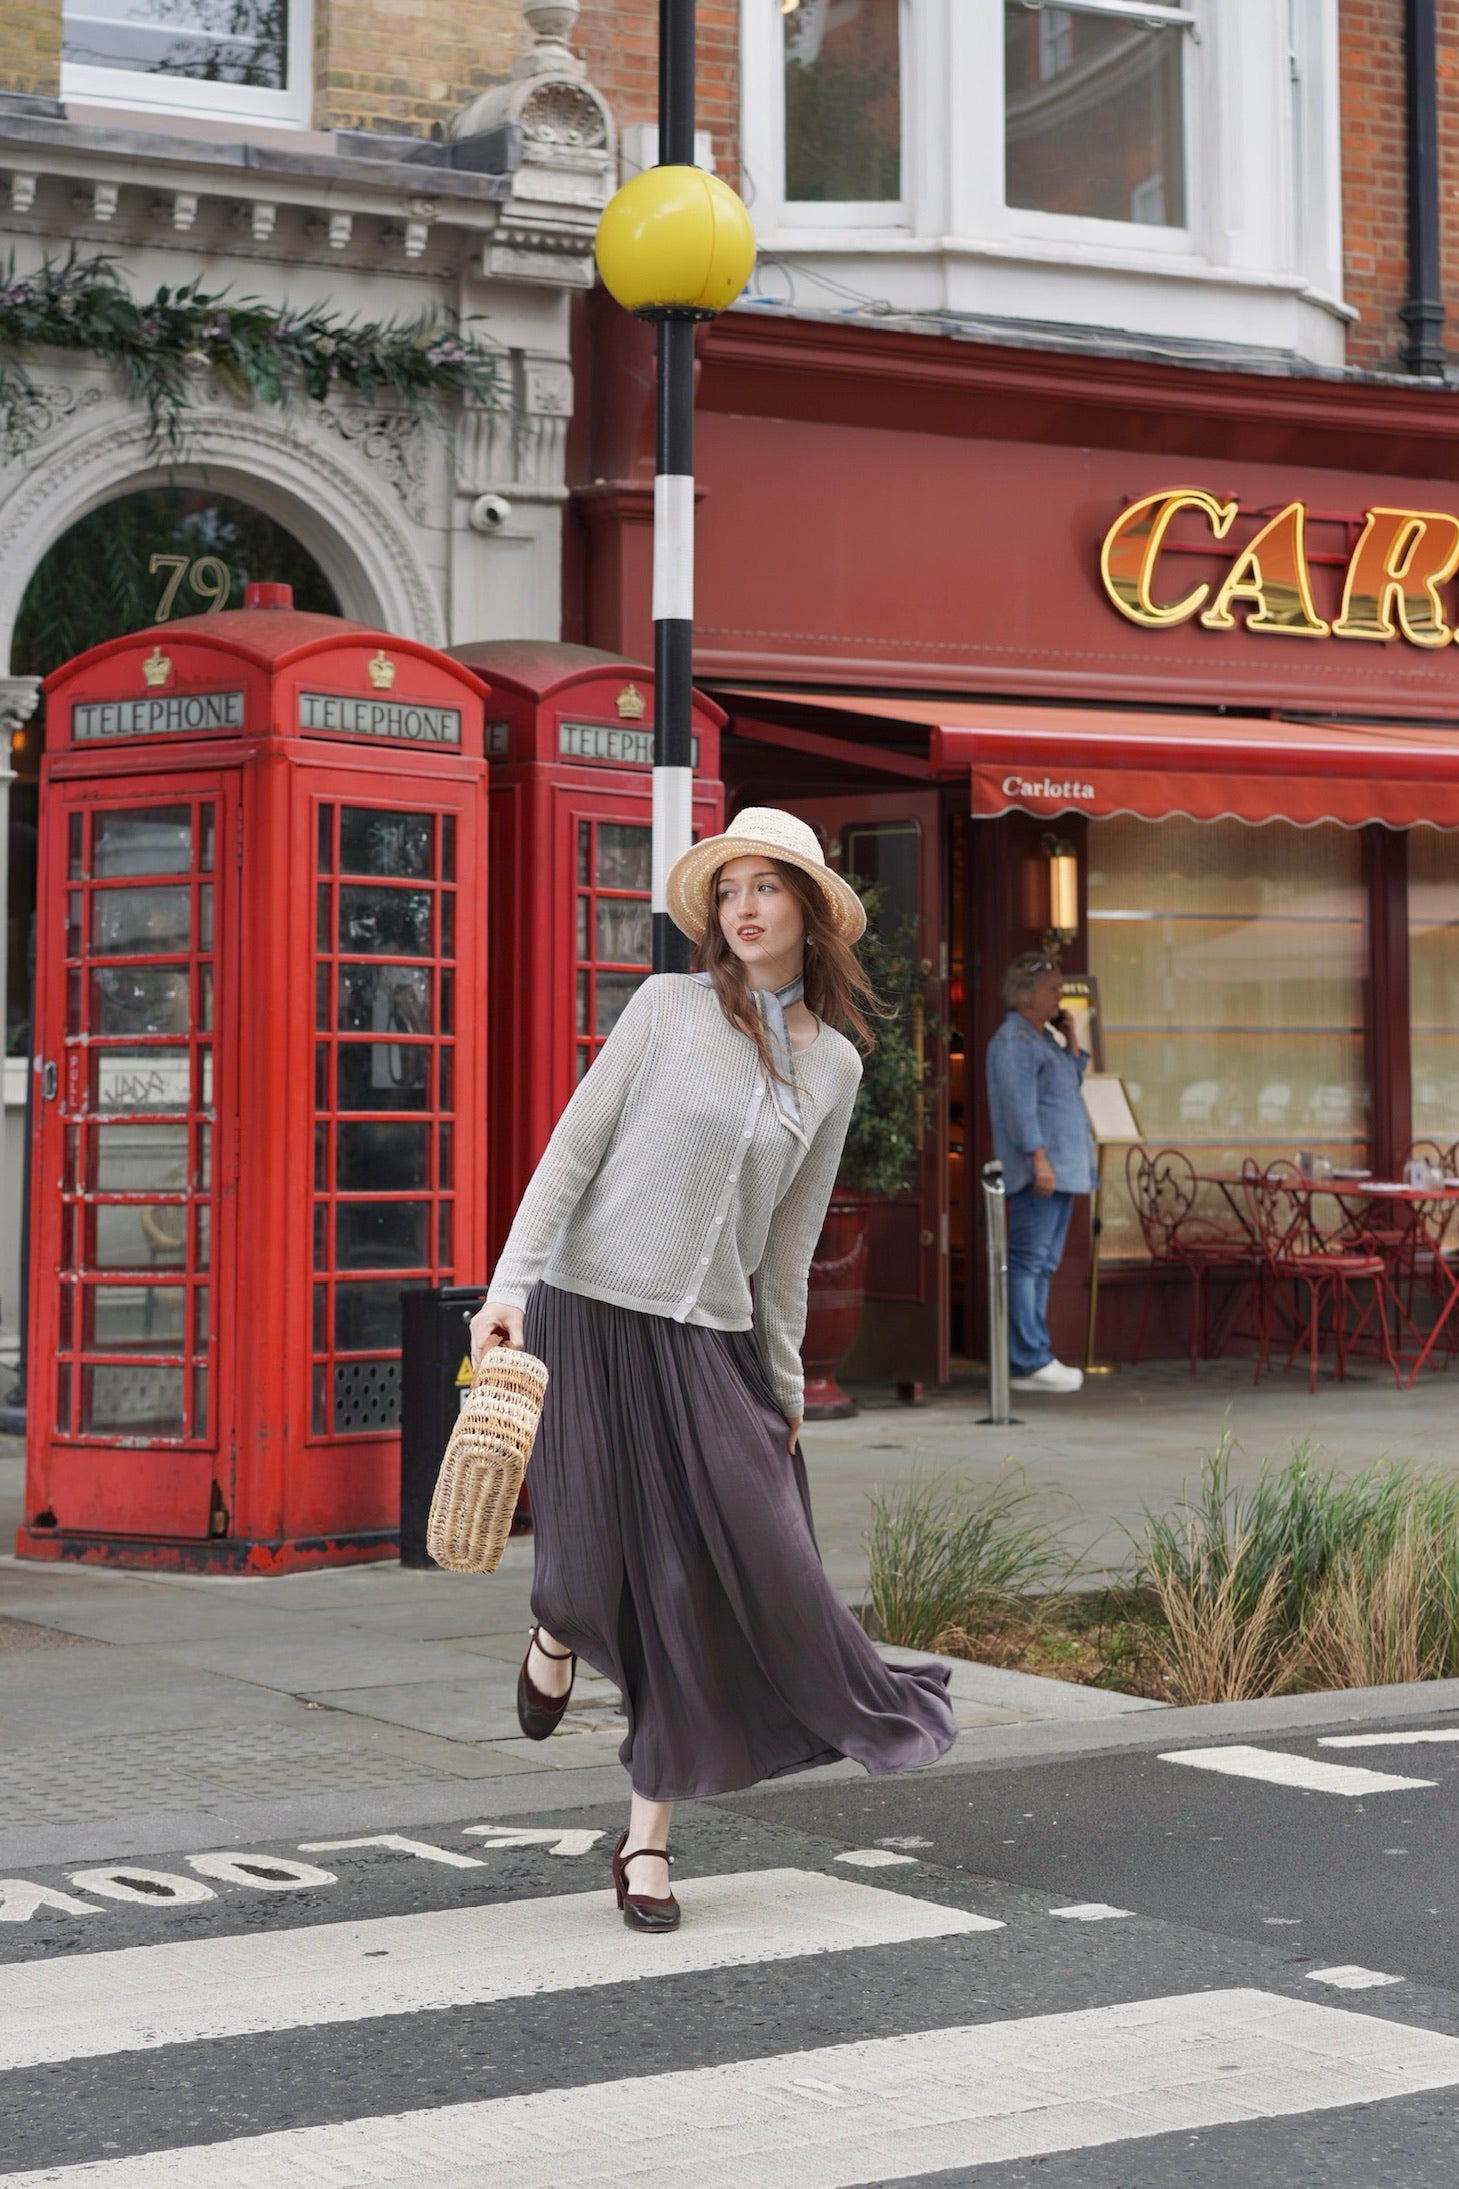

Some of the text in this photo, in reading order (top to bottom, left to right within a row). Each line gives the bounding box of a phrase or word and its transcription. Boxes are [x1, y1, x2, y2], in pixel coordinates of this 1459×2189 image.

[149, 553, 231, 623] 79
[1101, 485, 1459, 648] CAR
[81, 694, 239, 737] TELEPHONE
[304, 698, 453, 742] TELEPHONE
[563, 726, 655, 761] TELEPH
[1002, 775, 1095, 799] Carlotta
